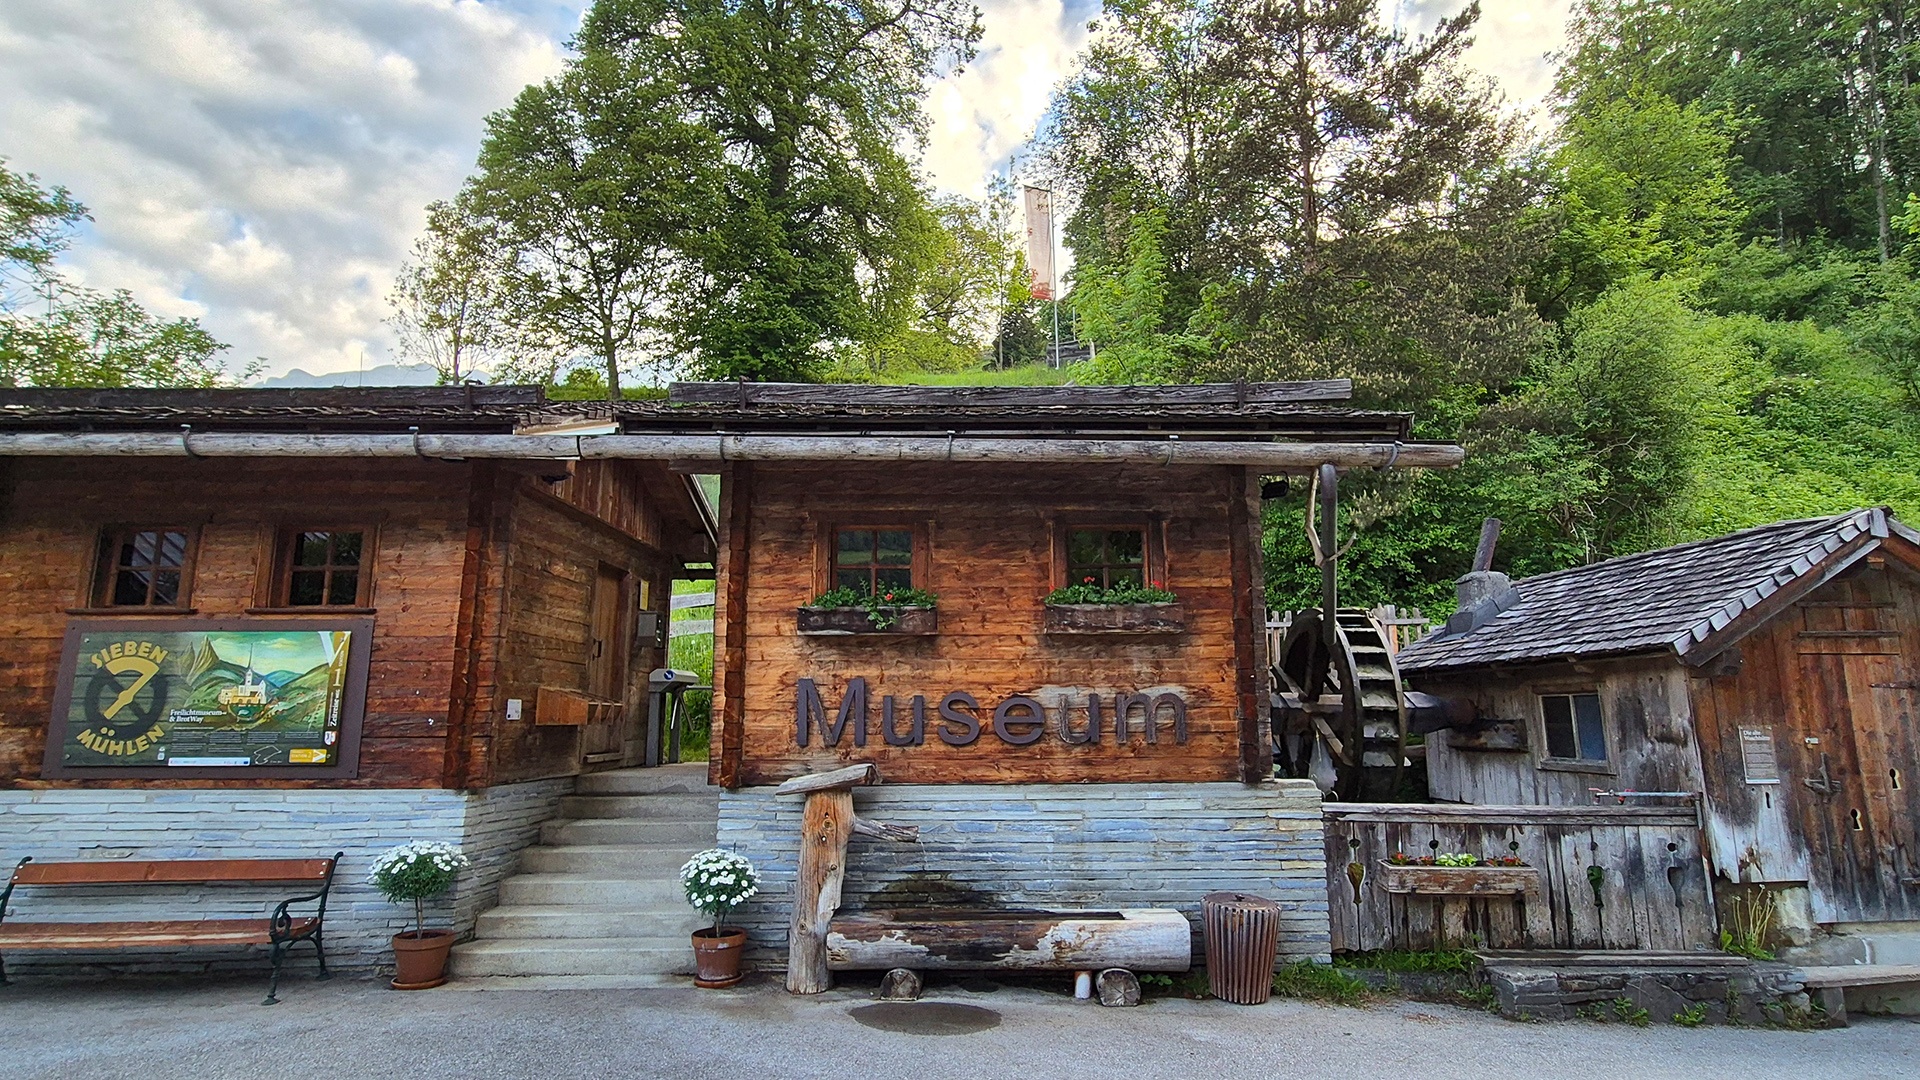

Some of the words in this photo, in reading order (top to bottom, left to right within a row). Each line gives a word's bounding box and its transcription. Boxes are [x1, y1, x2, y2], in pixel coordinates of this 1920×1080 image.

[91, 641, 168, 669] SIEBEN
[104, 656, 160, 720] 7
[795, 677, 1187, 747] Museum
[76, 725, 165, 755] MÜHLEN
